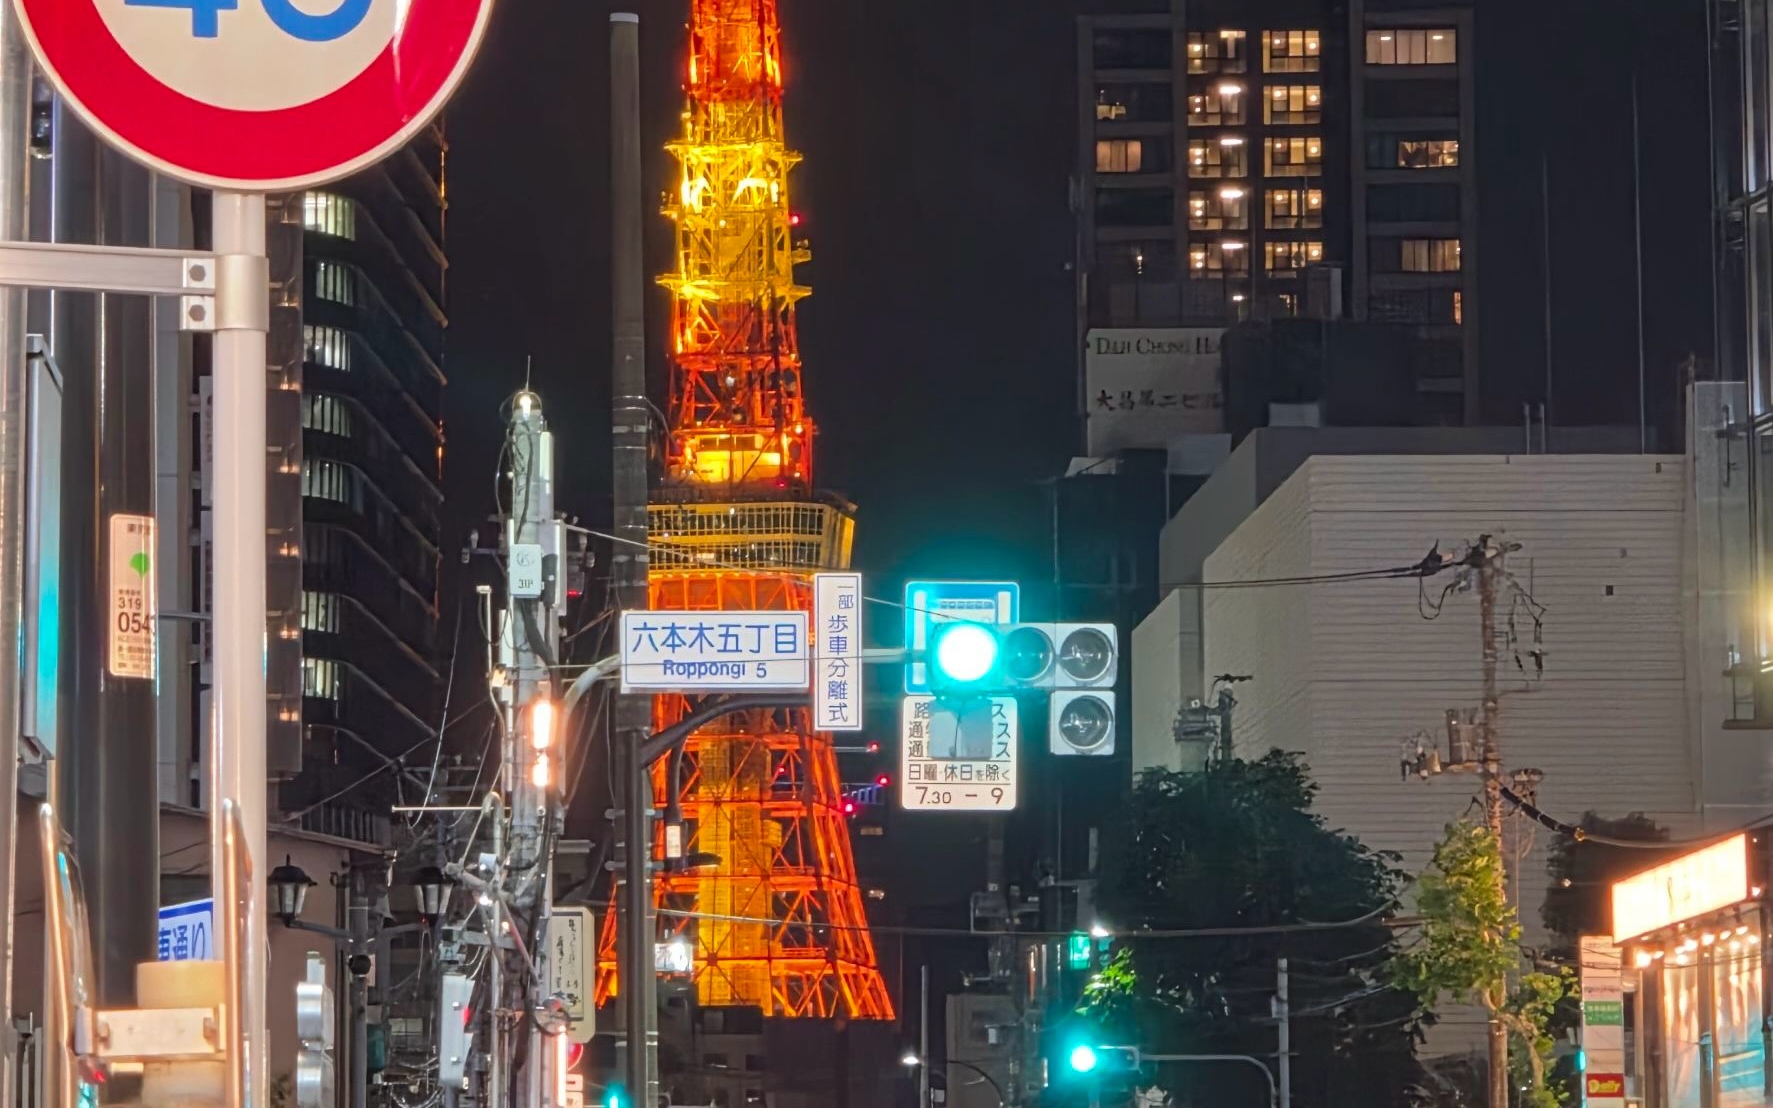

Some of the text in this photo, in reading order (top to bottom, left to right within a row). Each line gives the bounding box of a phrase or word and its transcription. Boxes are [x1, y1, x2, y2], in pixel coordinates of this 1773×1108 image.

[118, 597, 141, 610] 319
[632, 622, 797, 654] 六本木五丁目
[663, 660, 767, 679] Roppongi 5
[991, 787, 1004, 804] 9
